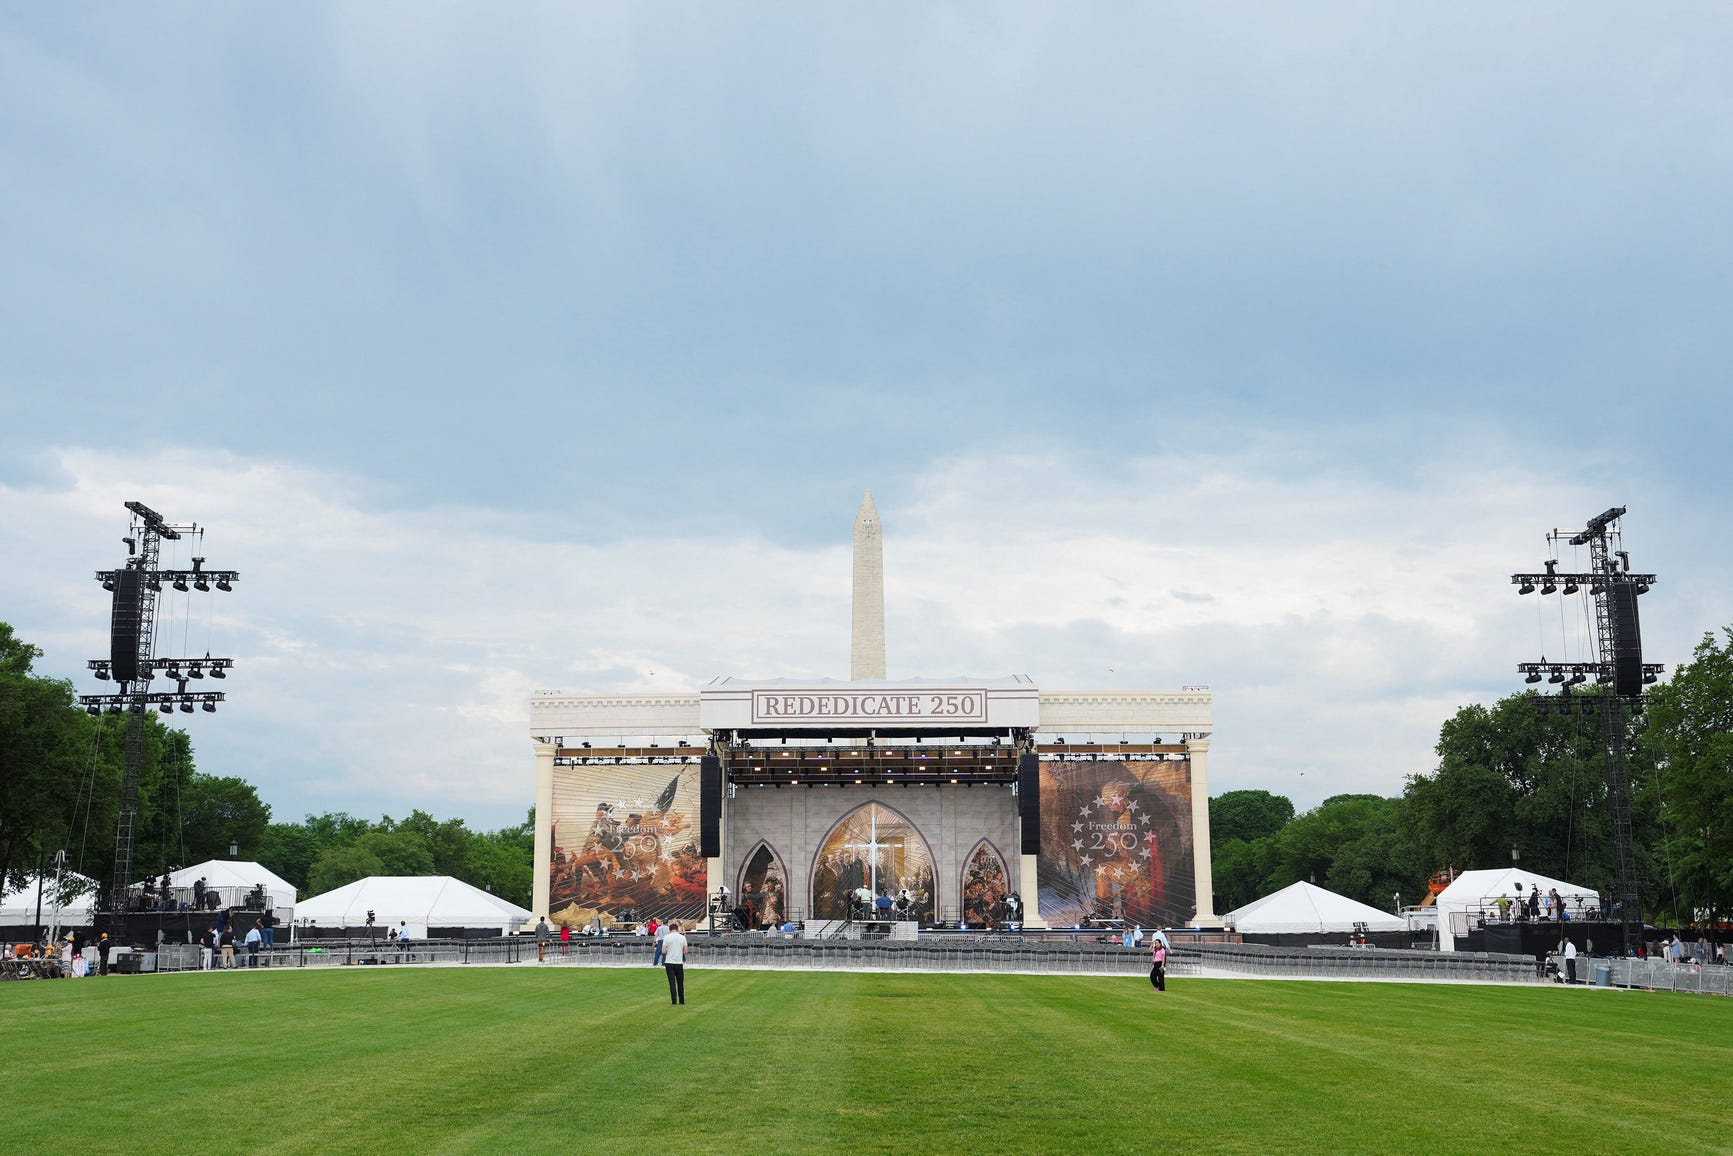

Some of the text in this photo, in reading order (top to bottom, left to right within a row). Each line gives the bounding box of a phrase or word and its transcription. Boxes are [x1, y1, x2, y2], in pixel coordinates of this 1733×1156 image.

[764, 695, 975, 715] REDEDICATE 250
[609, 824, 657, 834] Freedom
[1088, 821, 1137, 831] Freedom
[610, 835, 657, 860] 250
[1090, 832, 1138, 857] 250
